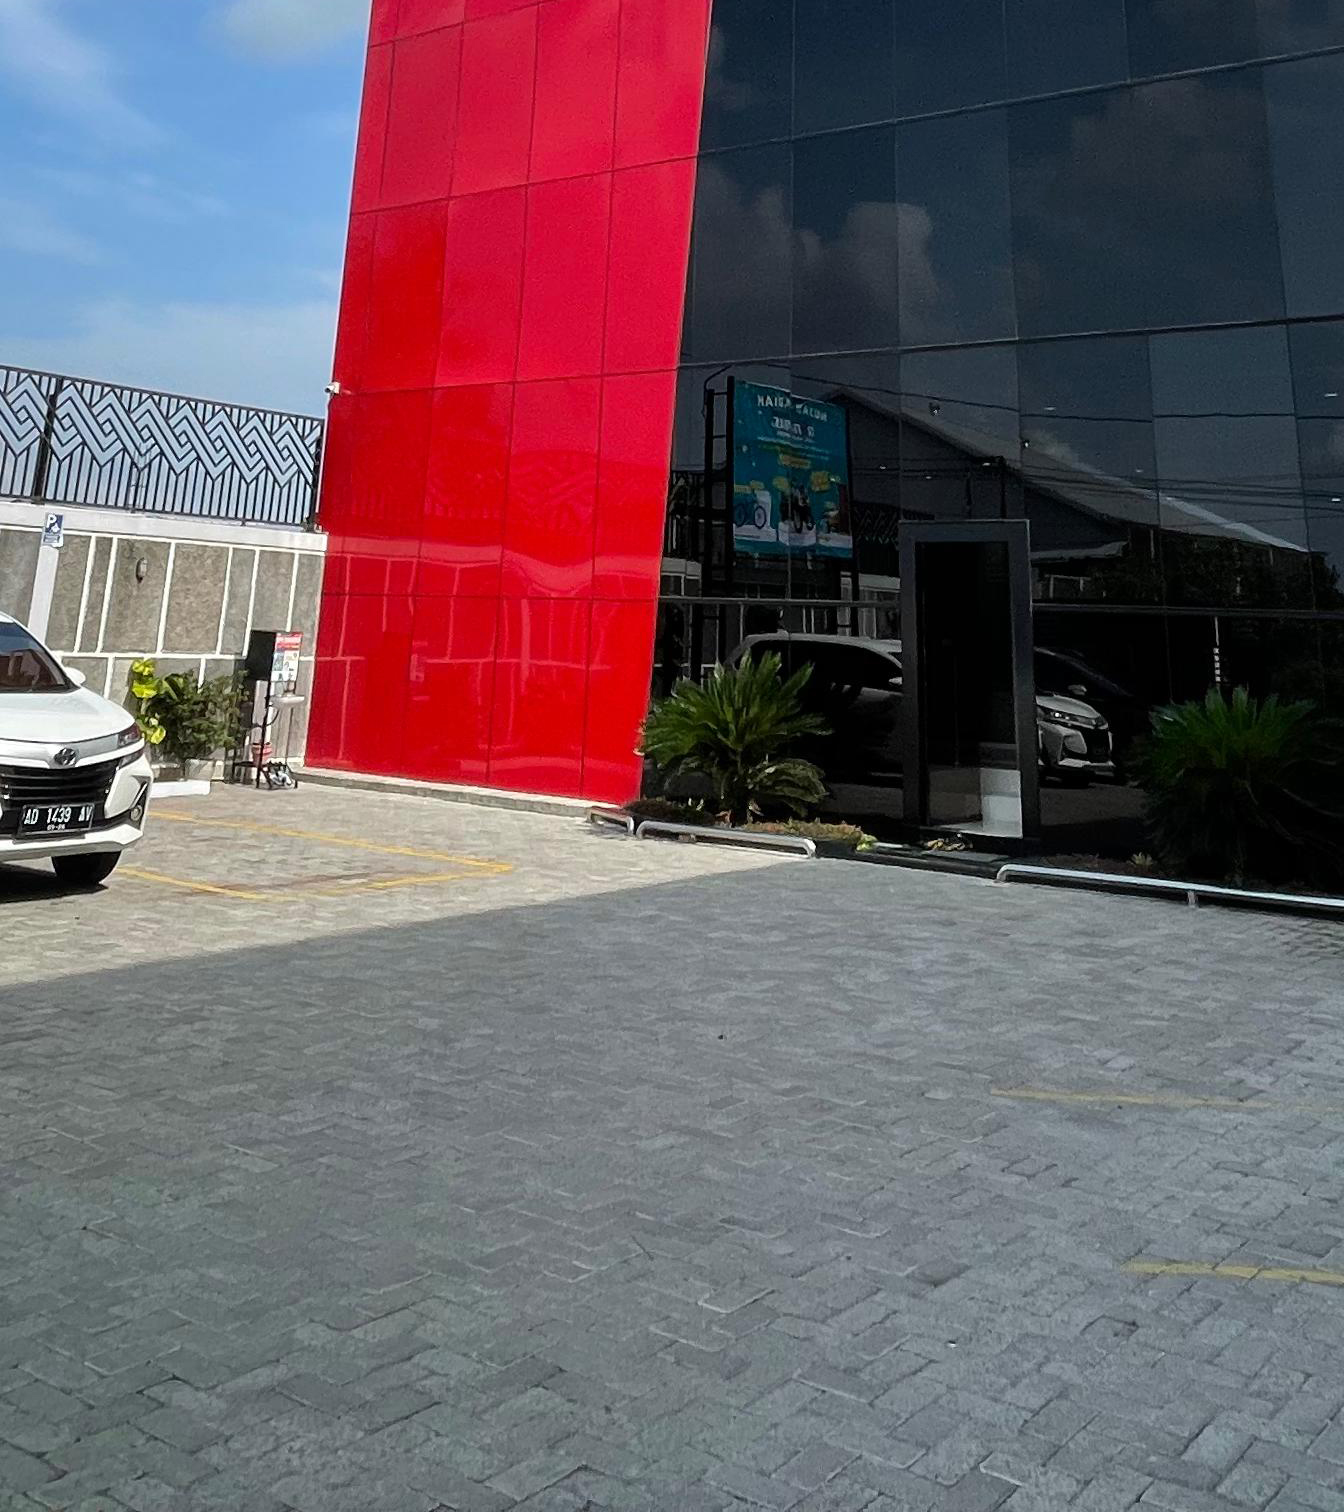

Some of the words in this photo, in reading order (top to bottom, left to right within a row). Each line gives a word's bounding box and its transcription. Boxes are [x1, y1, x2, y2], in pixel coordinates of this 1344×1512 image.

[23, 808, 40, 825] AD
[46, 807, 72, 824] 1439
[78, 806, 93, 822] AV
